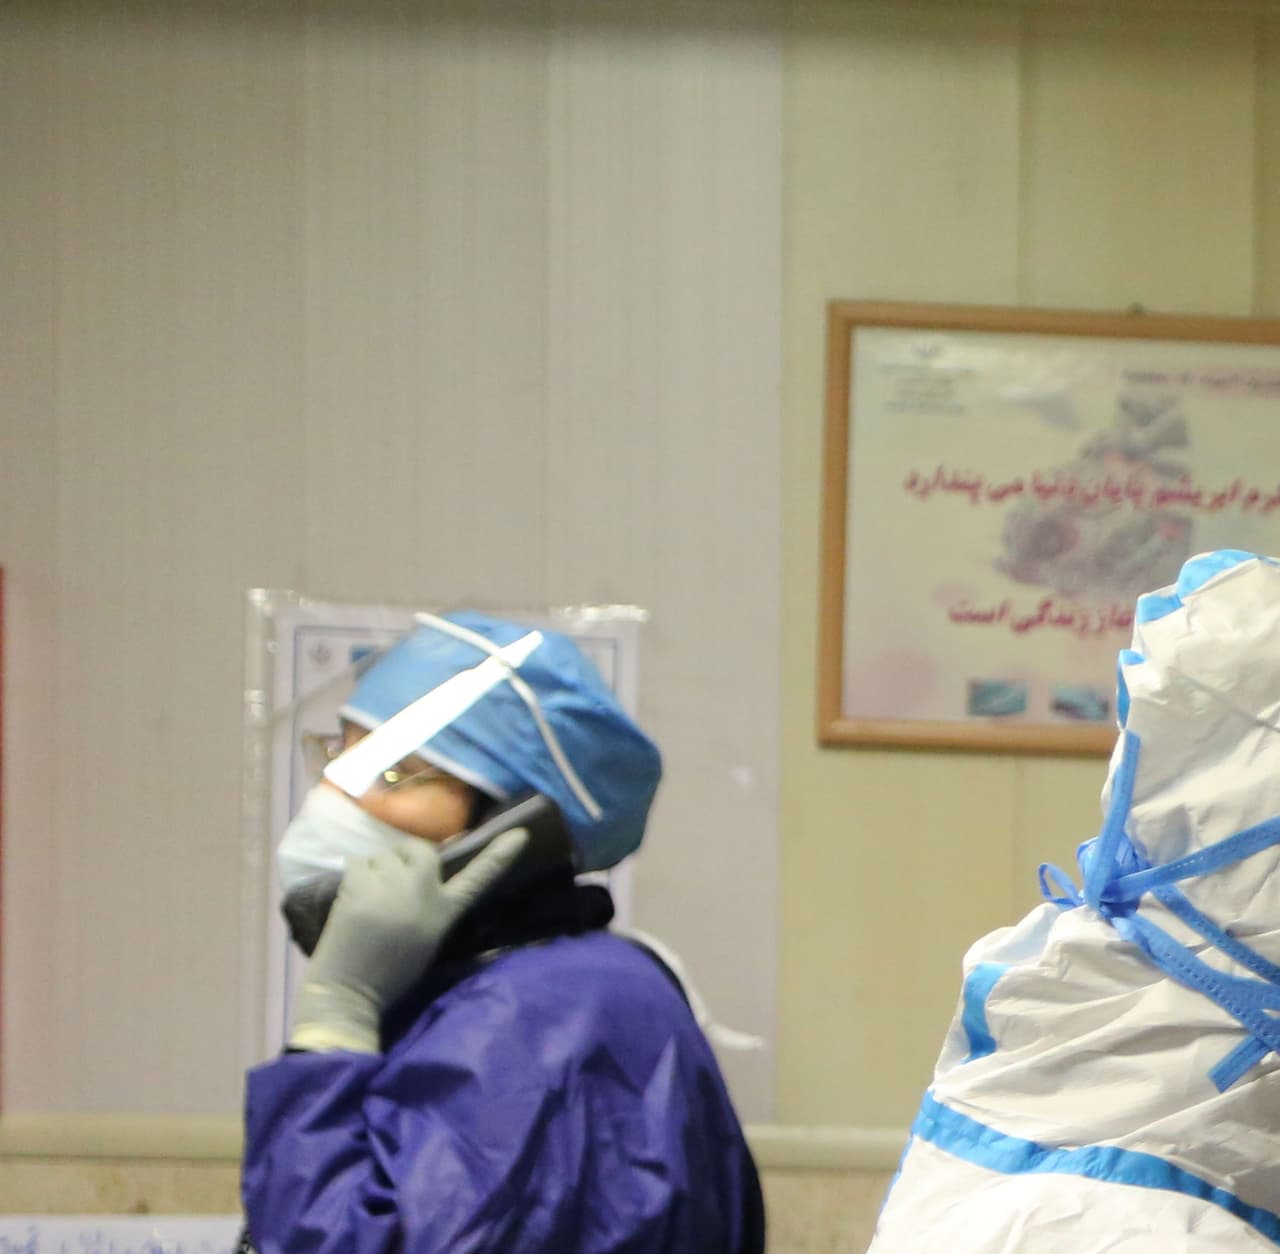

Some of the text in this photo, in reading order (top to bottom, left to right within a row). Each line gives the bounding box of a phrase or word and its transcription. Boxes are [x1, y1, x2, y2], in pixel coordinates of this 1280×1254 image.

[902, 463, 982, 508] پندارد
[985, 475, 1025, 503] می
[946, 596, 1011, 626] است
[1010, 597, 1091, 638] زندگی
